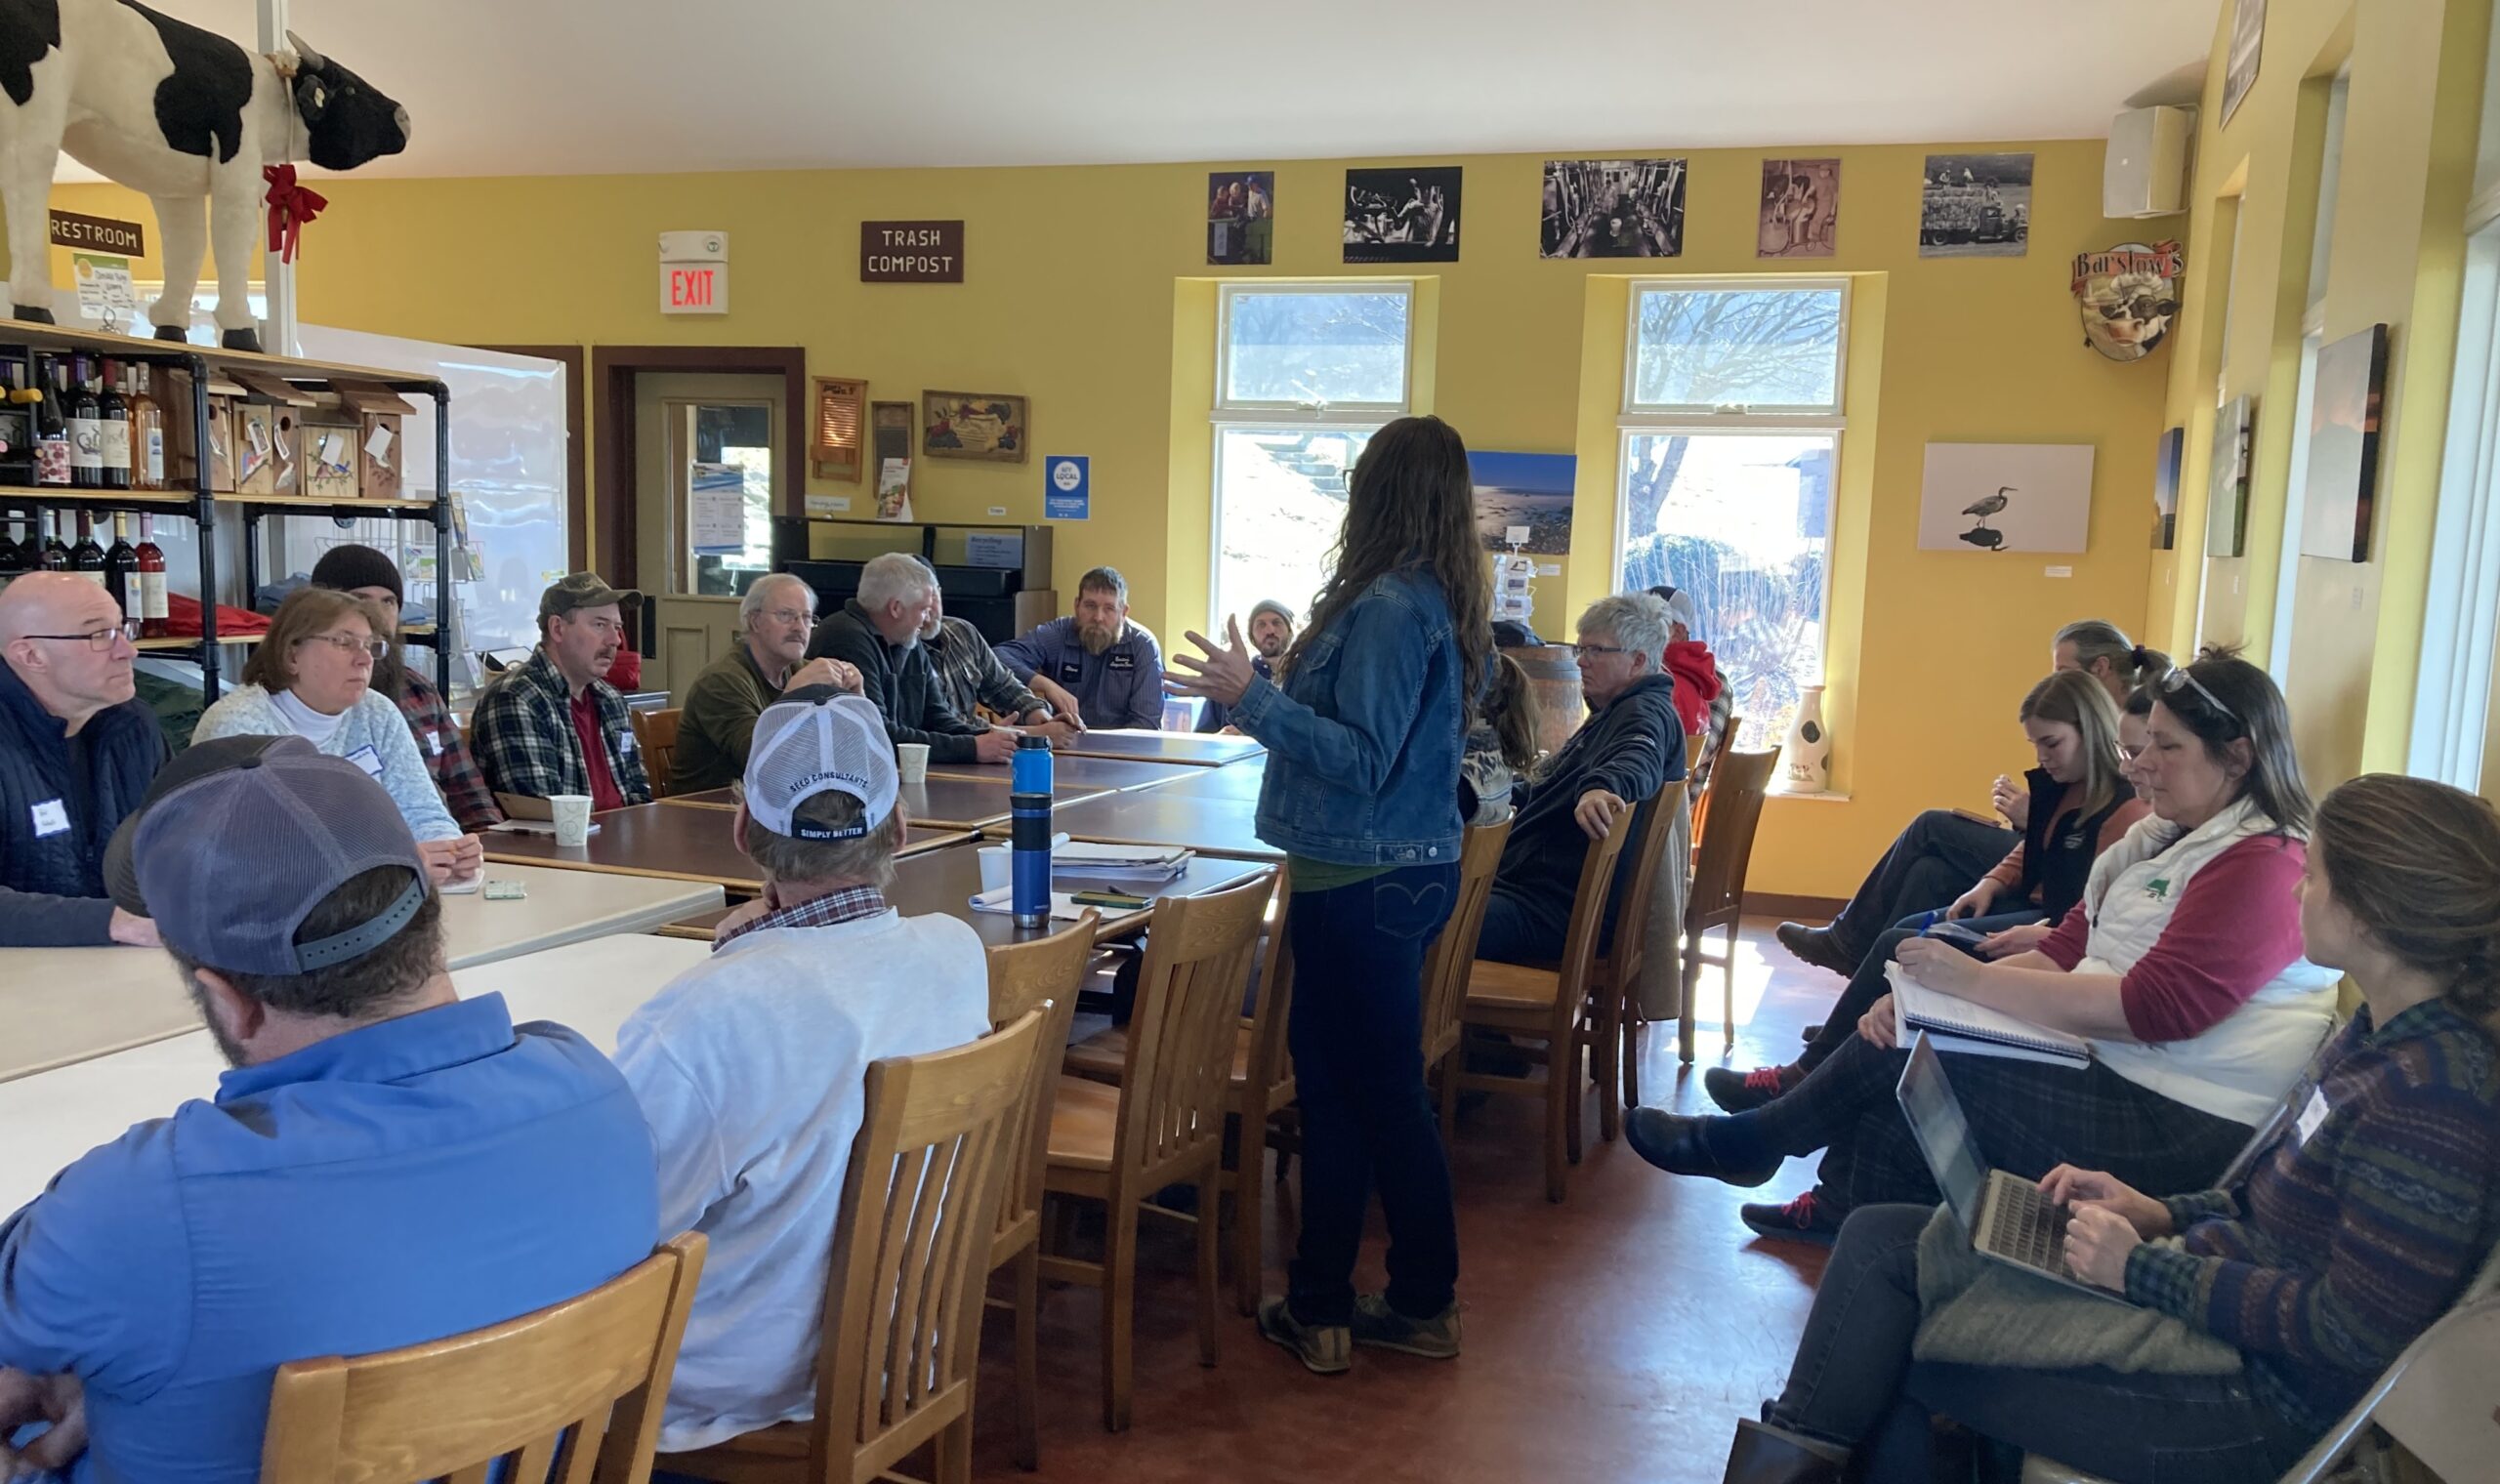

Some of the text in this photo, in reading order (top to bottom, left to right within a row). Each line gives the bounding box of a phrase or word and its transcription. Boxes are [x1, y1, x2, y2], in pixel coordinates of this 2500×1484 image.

[50, 219, 138, 249] RESTROOM
[882, 229, 941, 247] TRASH
[867, 255, 954, 273] COMPOST
[671, 269, 715, 307] EXIT
[790, 771, 868, 792] SEED CONSULTANTS
[801, 827, 863, 839] SIMPLY BETTER
